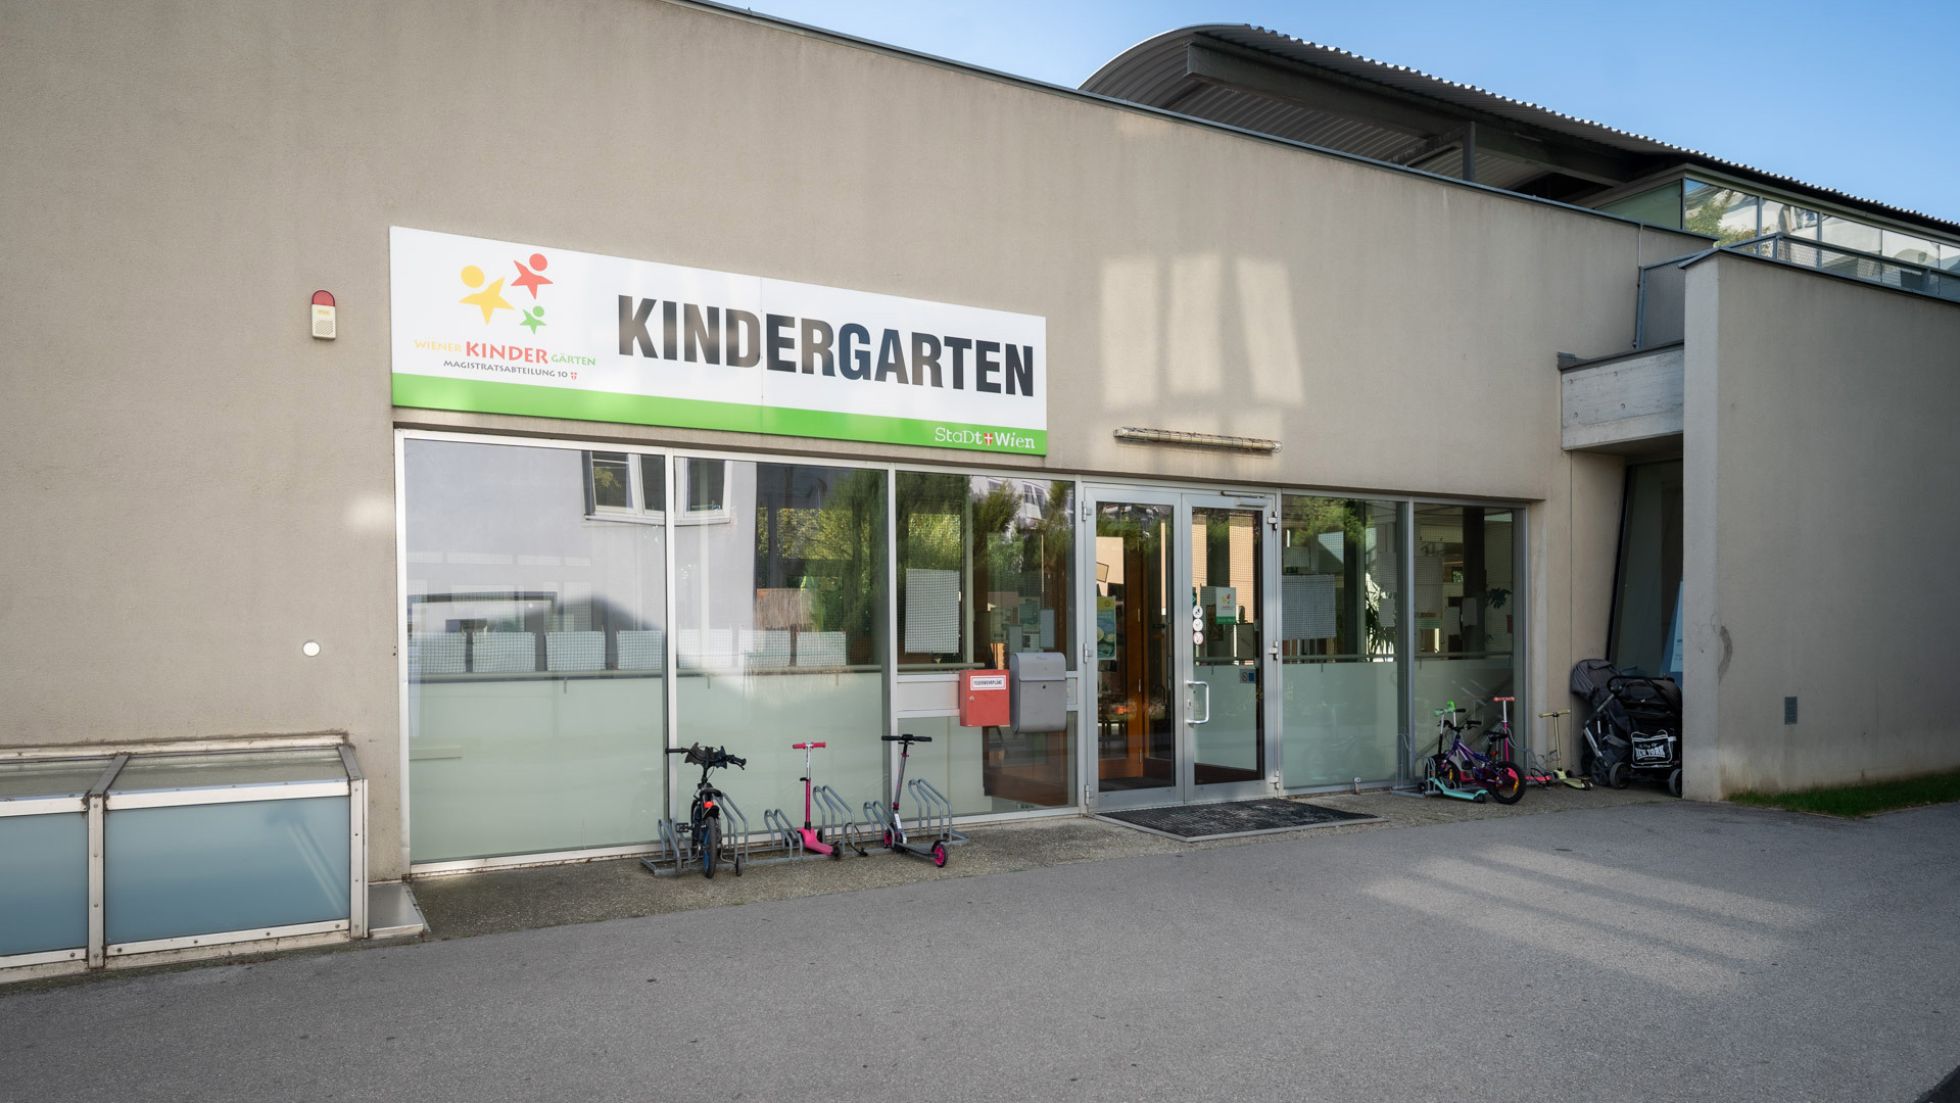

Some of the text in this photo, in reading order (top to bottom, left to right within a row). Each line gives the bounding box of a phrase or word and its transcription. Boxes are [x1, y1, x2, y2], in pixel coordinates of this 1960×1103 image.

[414, 339, 462, 353] WIENER
[465, 341, 549, 365] KINDER
[618, 294, 1034, 397] KINDERGARTEN
[443, 360, 568, 378] MAGISTRATSABTEILUNG 10
[994, 431, 1036, 449] Wien
